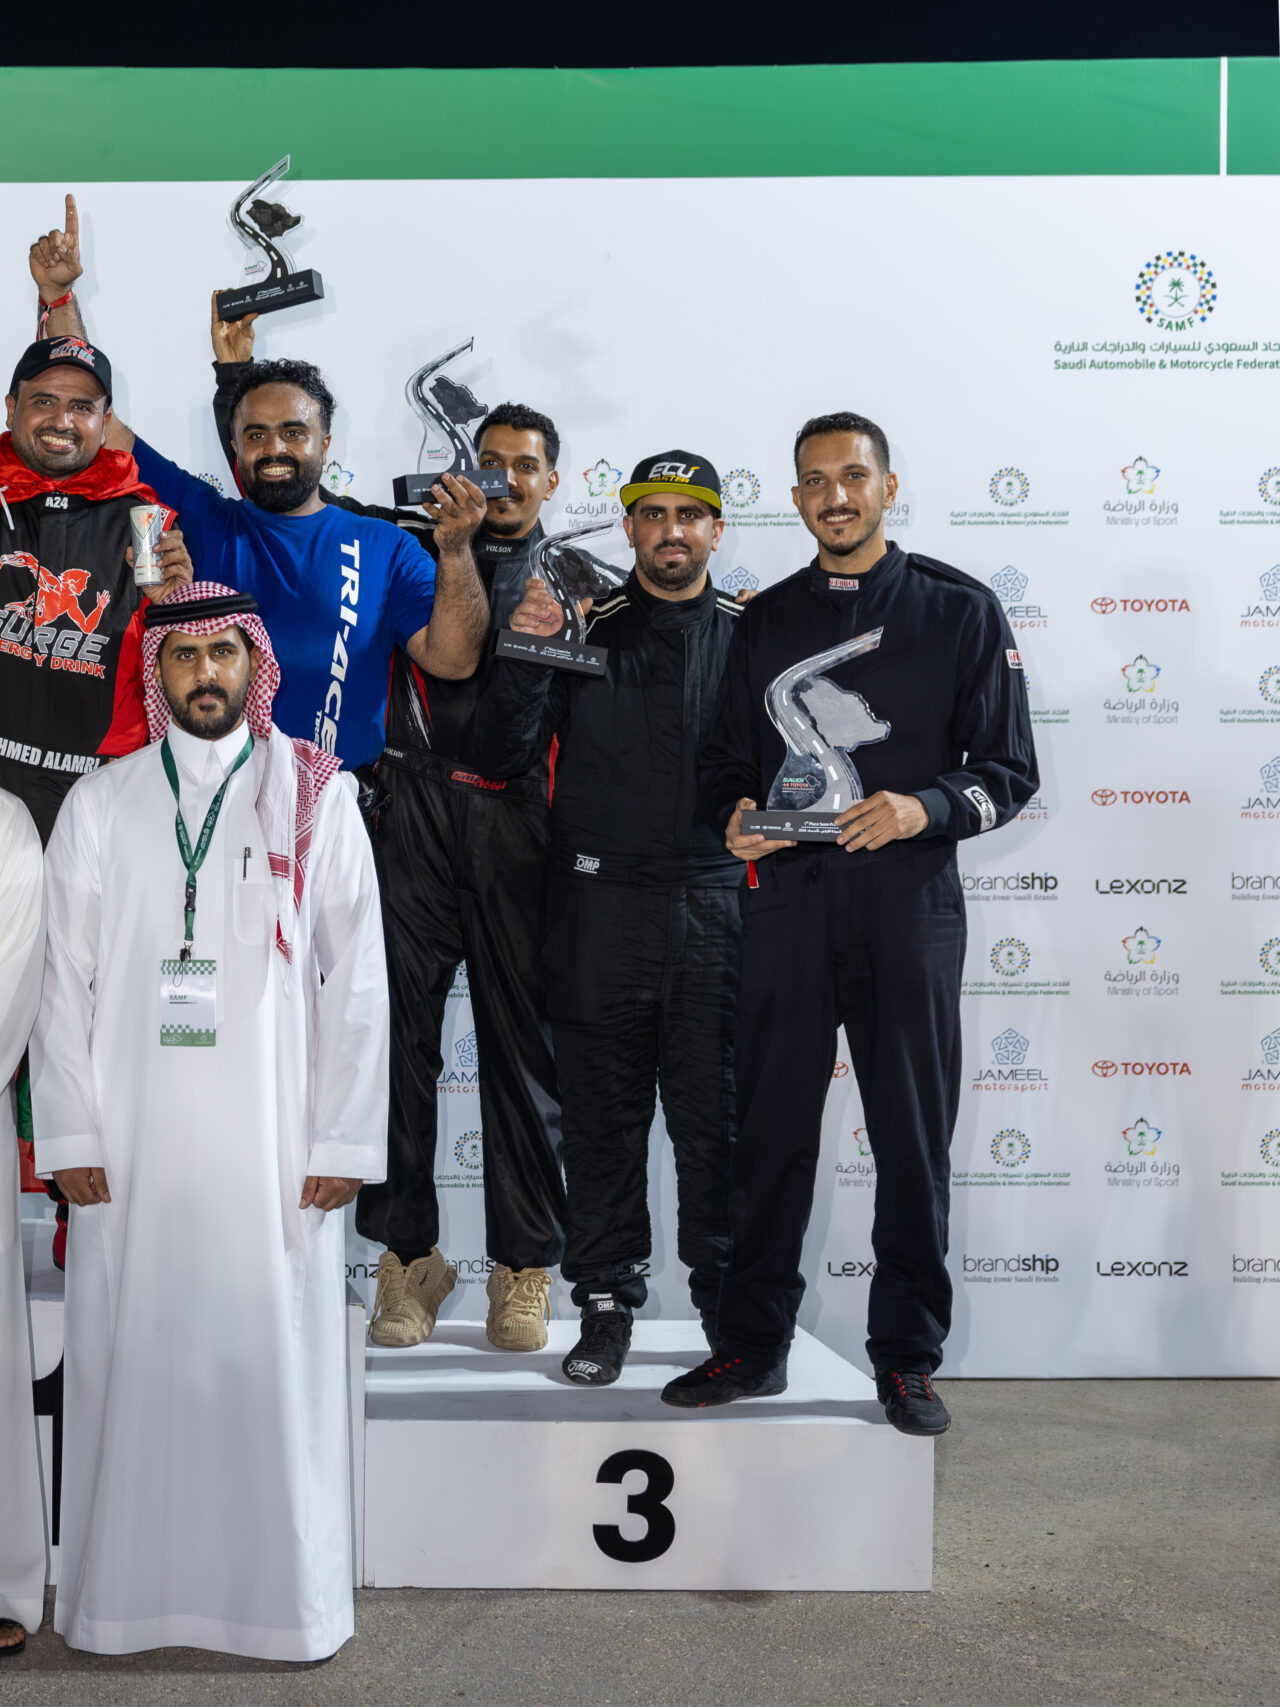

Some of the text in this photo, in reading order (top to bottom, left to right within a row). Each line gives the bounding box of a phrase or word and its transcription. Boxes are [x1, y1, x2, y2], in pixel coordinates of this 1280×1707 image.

[1157, 316, 1195, 332] SAMF
[1054, 341, 1088, 354] النارية
[1092, 341, 1146, 354] والدراجات
[1150, 341, 1201, 354] للسيارات
[1205, 341, 1258, 355] السعودي
[1054, 358, 1280, 372] Saudi Automobile & Motorcycle Federat
[648, 462, 700, 478] ECU
[45, 497, 69, 510] A24
[1103, 500, 1179, 514] وزارة الرياضة
[1107, 517, 1139, 527] Ministry
[1154, 517, 1178, 527] Sport
[485, 545, 512, 553] VOLSON
[1120, 600, 1190, 612] TOYOTA
[321, 539, 360, 756] TRI-ACE
[51, 656, 106, 680] DRINK
[42, 750, 100, 774] ALAMRI
[1120, 791, 1191, 804] TOYOTA
[576, 857, 600, 871] OMP
[972, 1069, 1049, 1080] JAMEEL
[1121, 1063, 1191, 1075] TOYOTA
[972, 1083, 1049, 1093] motorsport
[1104, 1161, 1180, 1175] وزارة الرياضة
[1108, 1178, 1140, 1188] Ministry
[1155, 1178, 1179, 1188] Sport
[828, 1262, 877, 1277] Lex
[568, 1362, 598, 1374] OMP
[592, 1450, 676, 1563] 3
